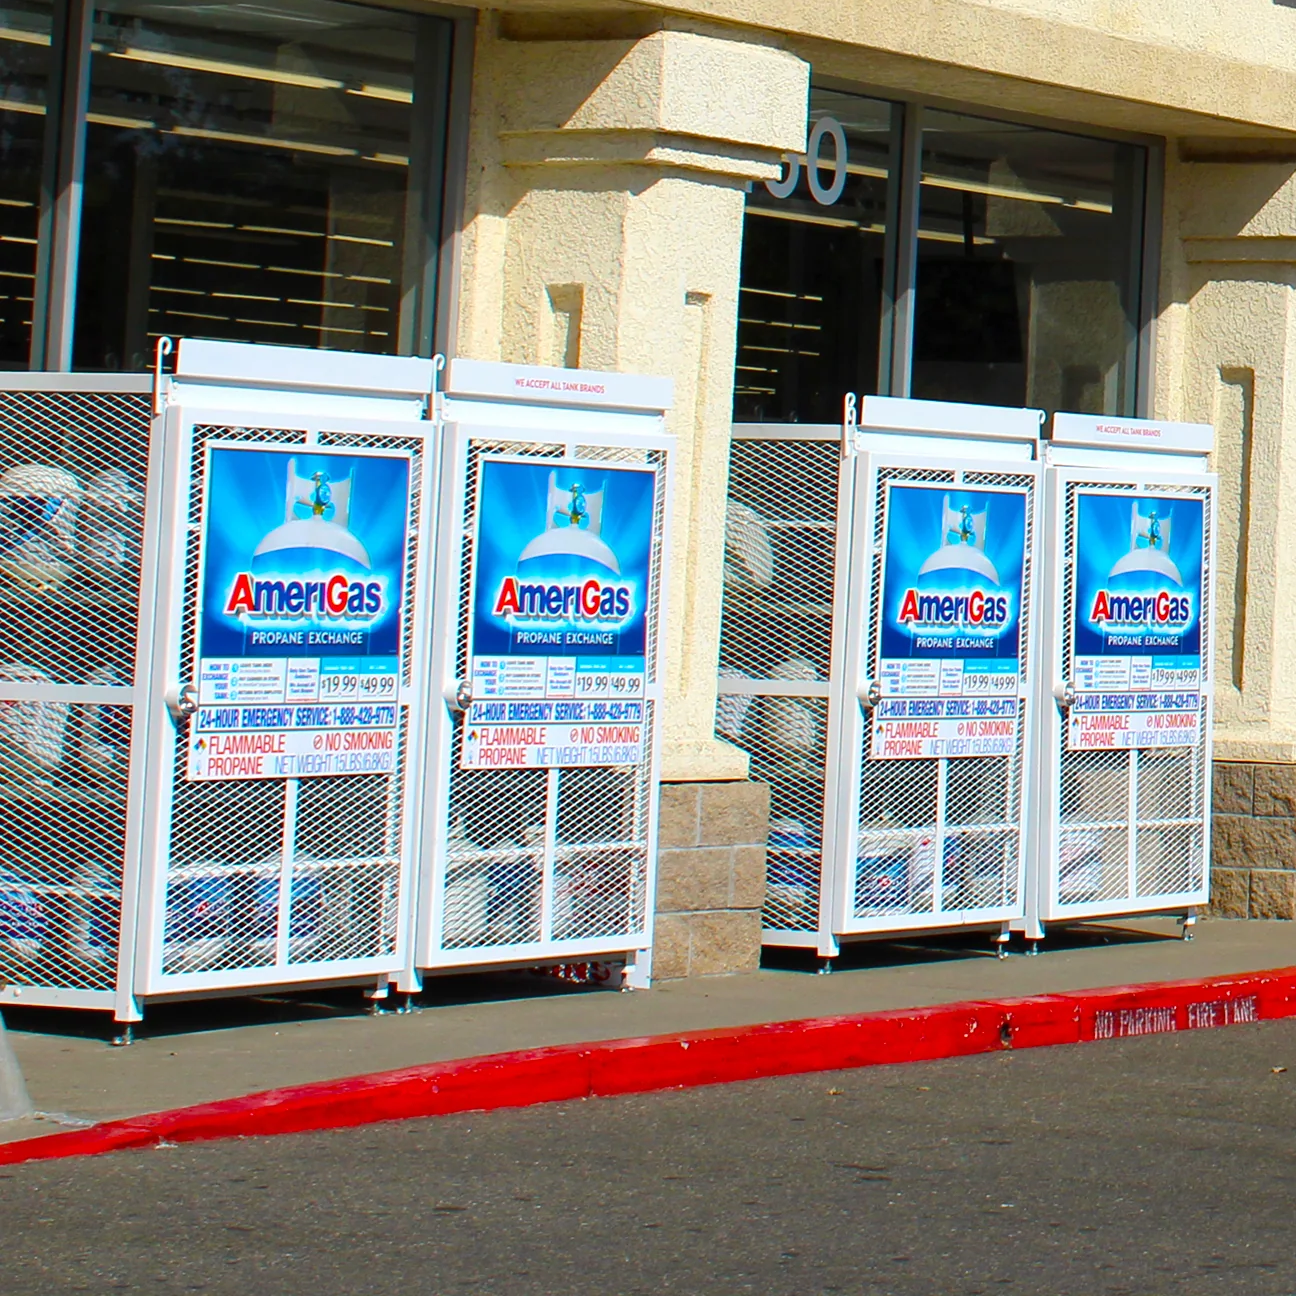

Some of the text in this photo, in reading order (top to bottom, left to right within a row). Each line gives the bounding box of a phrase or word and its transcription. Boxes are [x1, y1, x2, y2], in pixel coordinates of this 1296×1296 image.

[515, 379, 605, 394] WE ACCEPT ALL TANK BRANDS
[224, 572, 383, 615] AmeriGas
[493, 577, 632, 617] AmeriGas
[899, 589, 1008, 623] AmeriGas
[1090, 590, 1190, 622] AmeriGas
[252, 631, 363, 645] PROPANE EXCHANGE
[517, 632, 614, 645] PROPANE EXCHANGE
[916, 637, 994, 648] PROPANE EXCHANGE
[1108, 636, 1179, 646] PROPANE EXCHANGE
[322, 676, 395, 695] $19.99 $49.99
[578, 676, 608, 692] $19.99
[611, 677, 640, 693] $49.99
[473, 703, 506, 720] 24-HOUR
[508, 703, 554, 720] EMERGENCY
[908, 700, 945, 716] EMERGENCY
[200, 708, 240, 729] 24-HOUR
[242, 707, 295, 727] EMERGENCY
[333, 706, 394, 725] 1-888-428-9779
[1080, 713, 1197, 730] FLAMMABLE NO SMOKING
[480, 726, 640, 745] FLAMMABLE NO SMOKING
[885, 721, 1014, 738] FLAMMABLE NO SMOKING
[209, 731, 393, 755] FLAMMABLE NO SMOKING
[884, 739, 923, 755] PROPANE
[1080, 732, 1115, 746] PROPANE
[479, 747, 527, 765] PROPANE
[537, 746, 555, 764] NET
[556, 746, 588, 764] WEIGHT
[208, 756, 263, 776] PROPANE
[274, 755, 296, 774] NET
[297, 753, 333, 773] WEIGHT
[1094, 1010, 1113, 1039] NO
[1119, 1006, 1177, 1037] PARKING
[1187, 1001, 1216, 1028] FIRE
